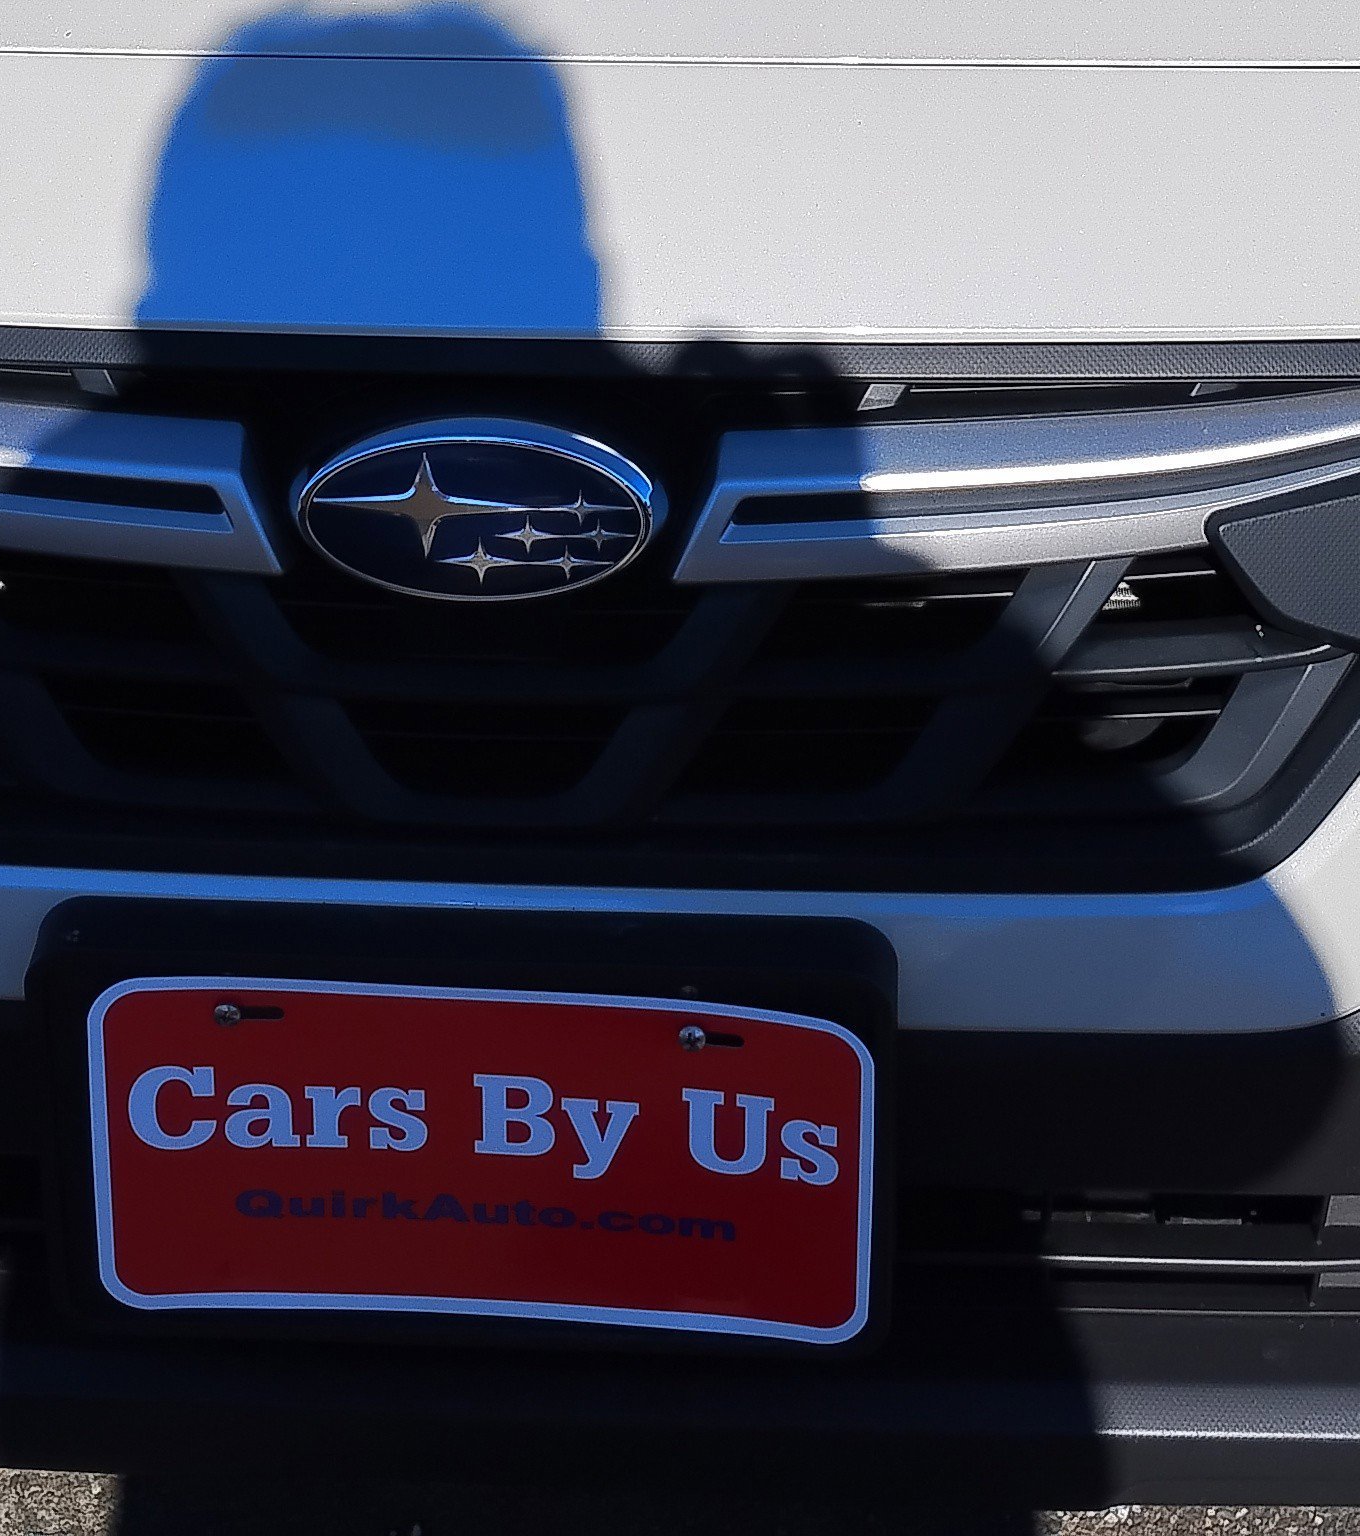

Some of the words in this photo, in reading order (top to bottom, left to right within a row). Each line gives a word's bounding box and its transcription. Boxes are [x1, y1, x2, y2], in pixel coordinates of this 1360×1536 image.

[127, 1065, 429, 1152] Cars
[472, 1072, 640, 1180] By
[681, 1087, 840, 1187] Us
[234, 1188, 737, 1242] QuirkAuto.com
